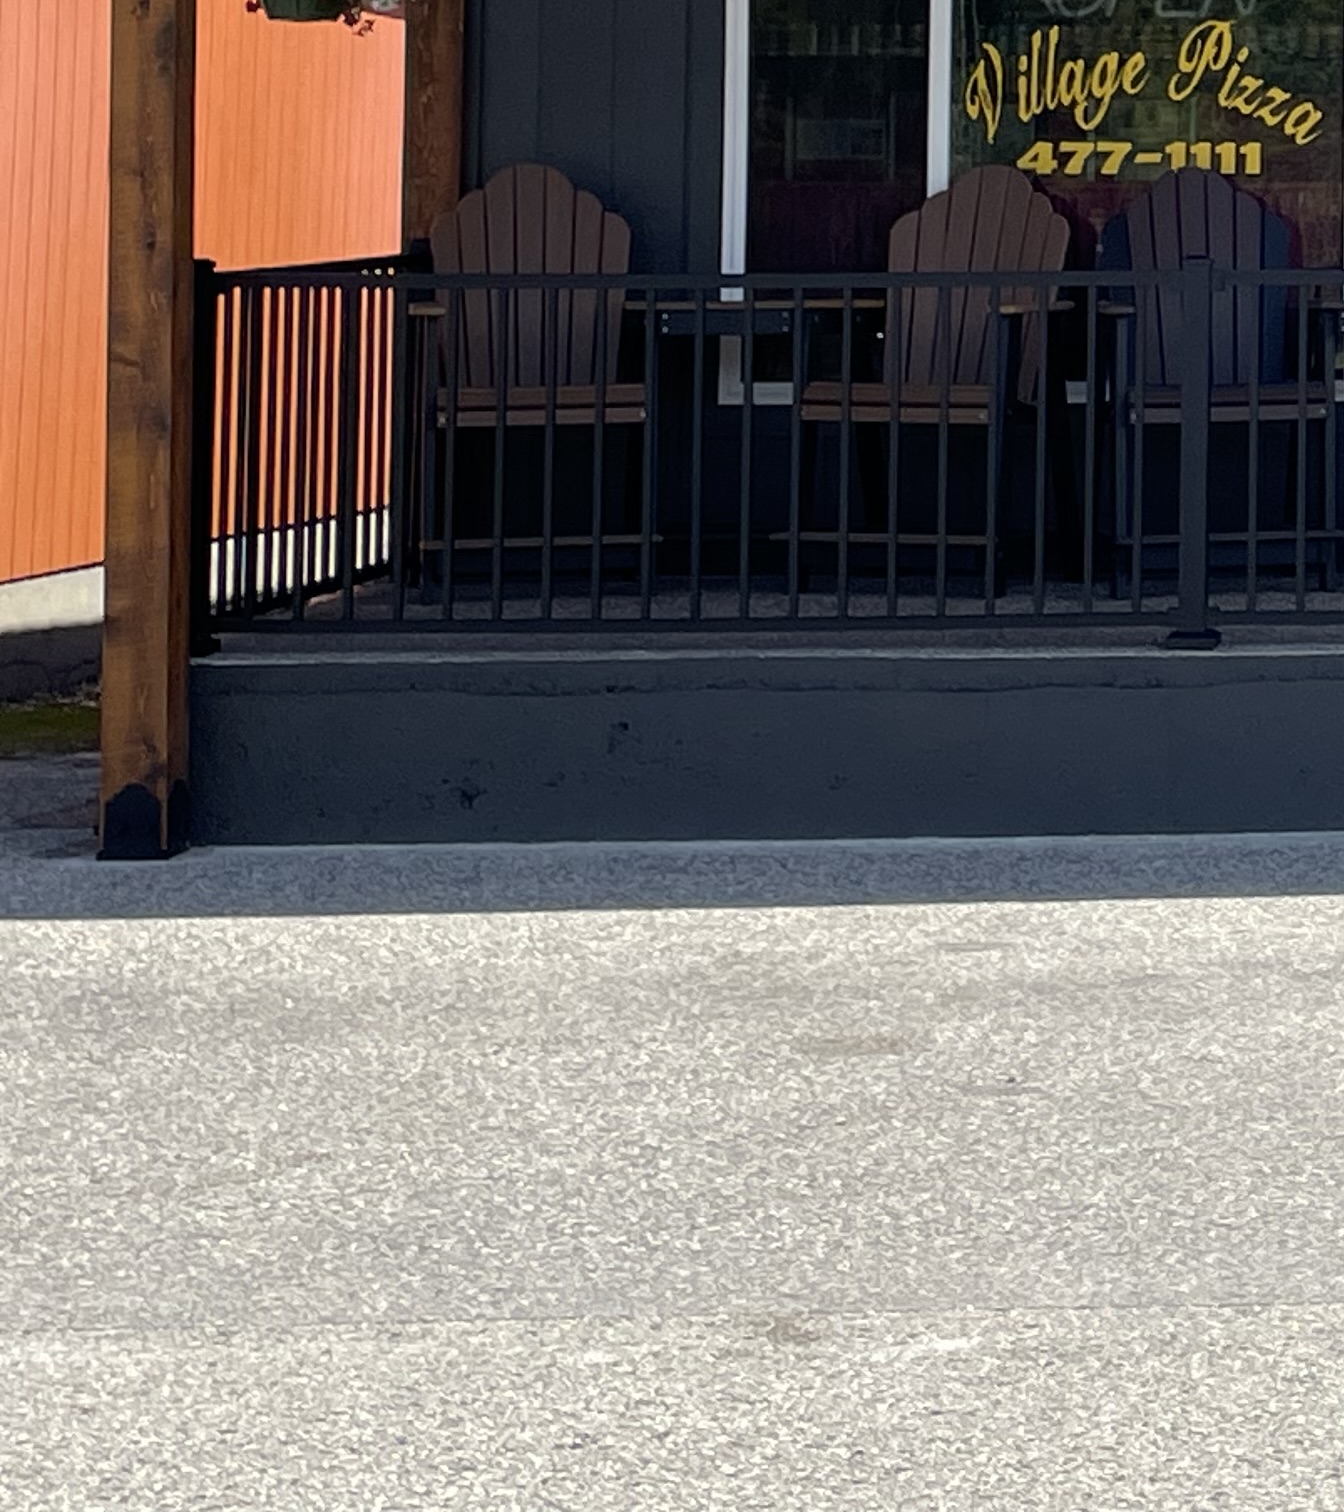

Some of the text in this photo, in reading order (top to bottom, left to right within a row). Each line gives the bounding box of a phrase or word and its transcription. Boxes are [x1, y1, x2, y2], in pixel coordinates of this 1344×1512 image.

[965, 19, 1323, 146] Village Pizza
[1016, 141, 1263, 176] 477-1111
